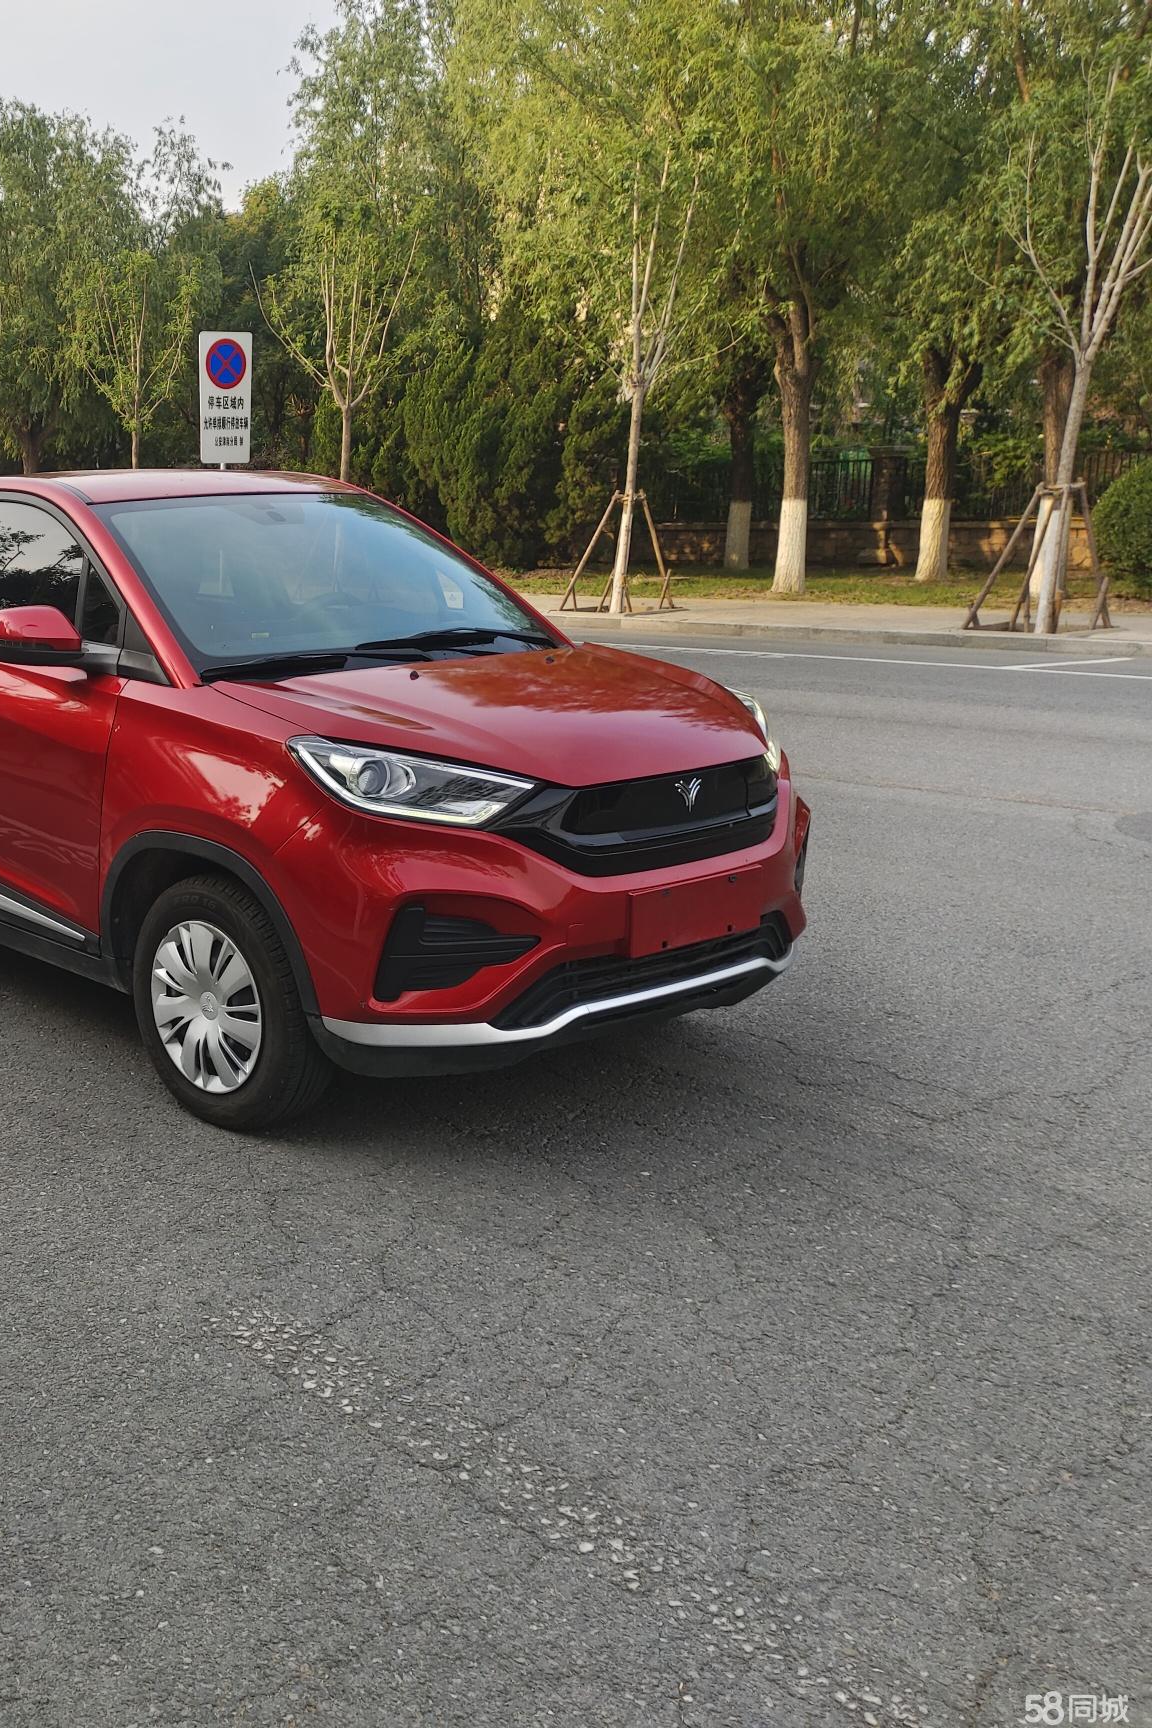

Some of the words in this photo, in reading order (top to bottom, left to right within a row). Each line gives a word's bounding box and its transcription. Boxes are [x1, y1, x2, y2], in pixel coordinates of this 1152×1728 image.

[208, 395, 244, 410] 停车区域内
